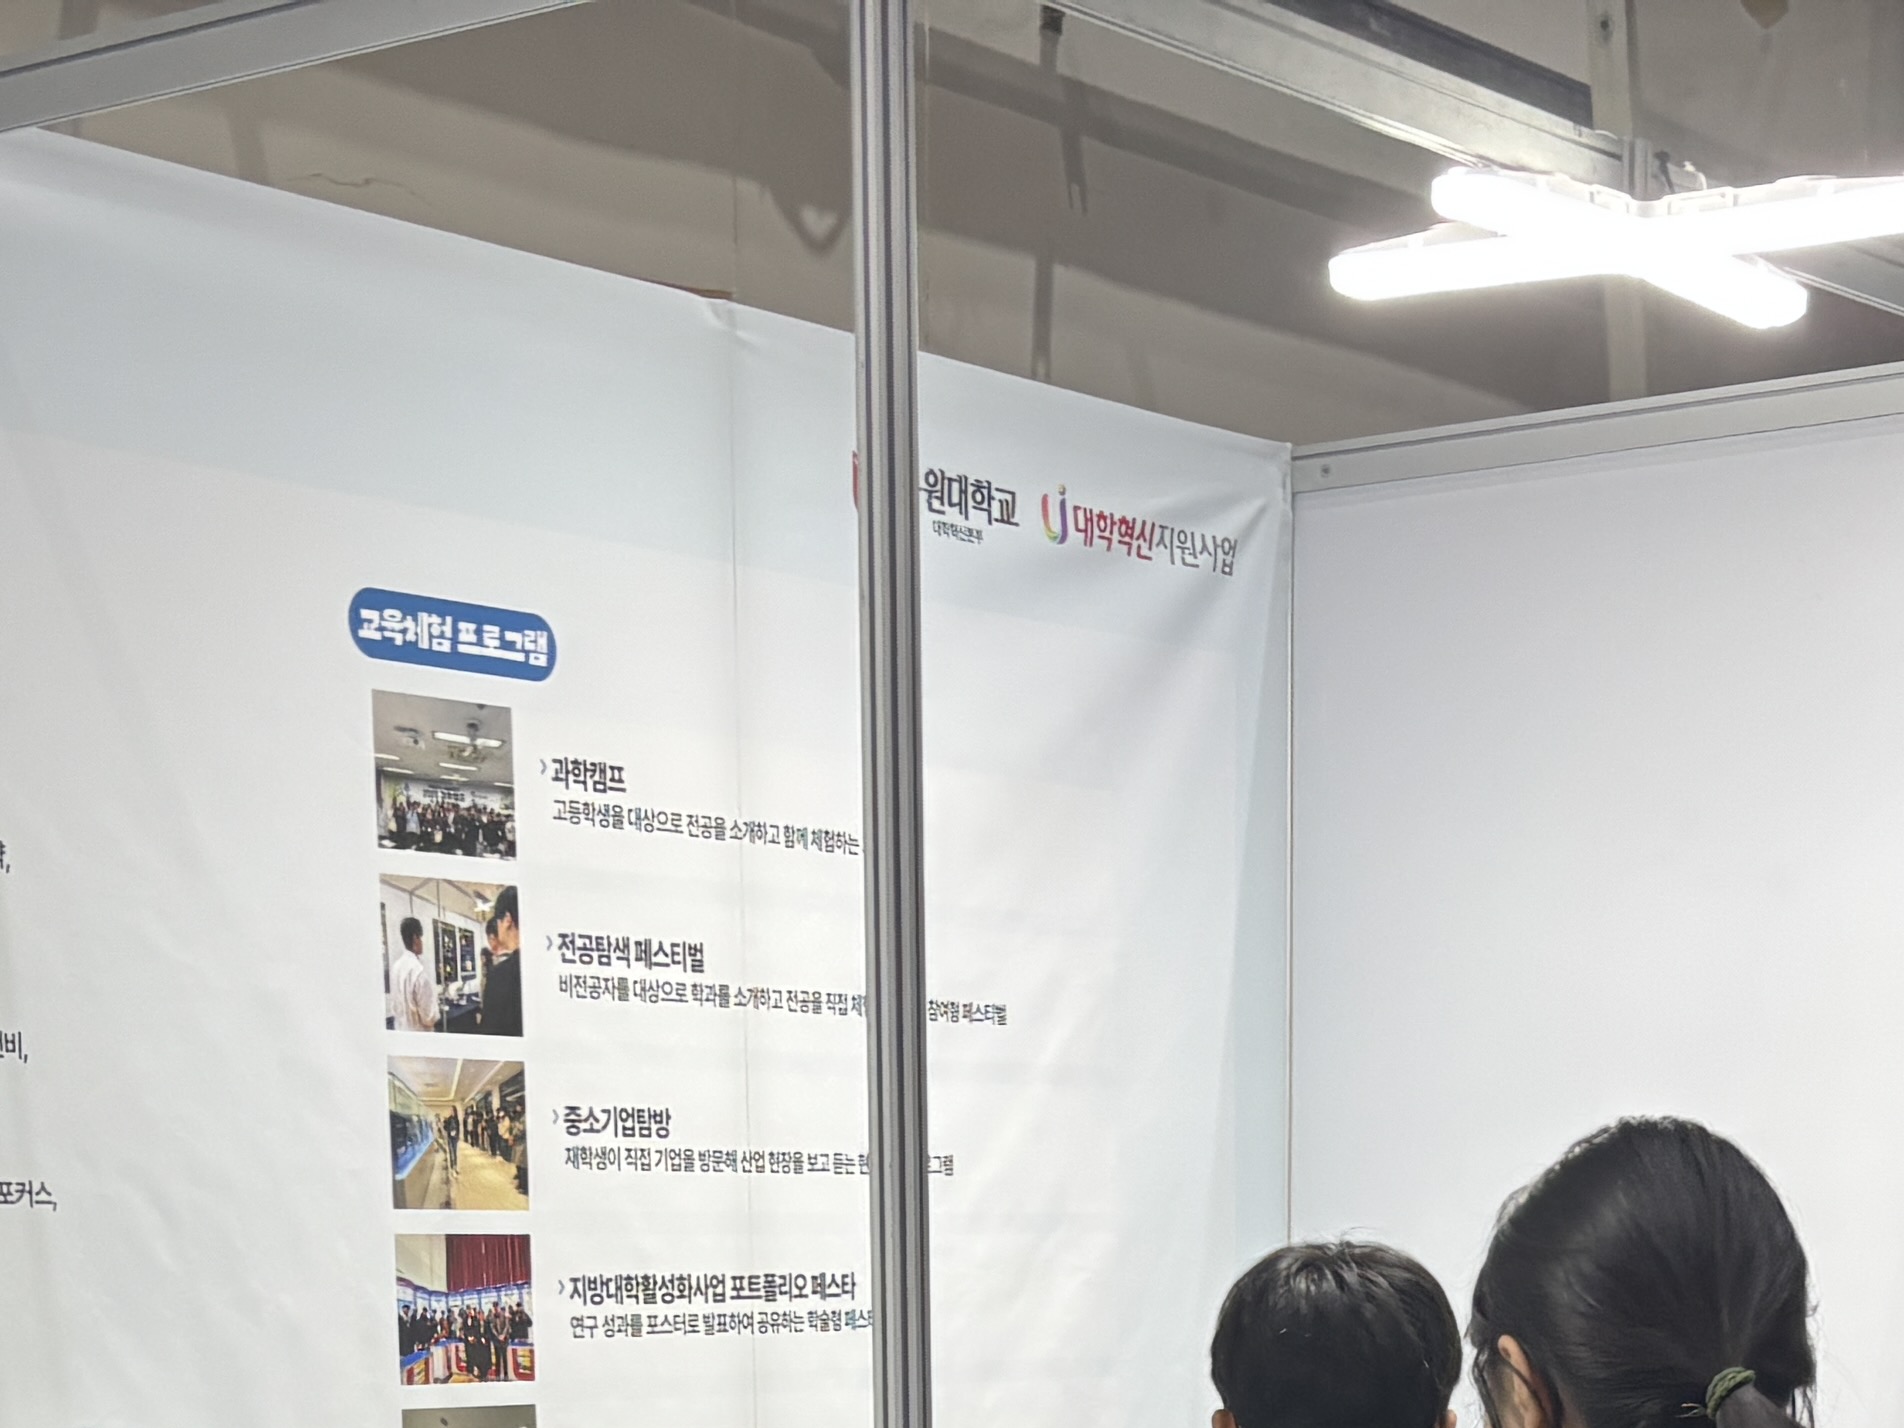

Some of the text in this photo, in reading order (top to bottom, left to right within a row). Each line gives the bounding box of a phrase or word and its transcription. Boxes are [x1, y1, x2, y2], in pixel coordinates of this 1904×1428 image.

[1073, 505, 1238, 576] 대학혁신지원사업
[358, 609, 547, 666] 교육체험 프로그램
[552, 757, 626, 793] 과학캠프
[628, 808, 684, 834] 대상으로
[686, 815, 726, 841] 전공을
[558, 932, 704, 973] 전공탐색 페스티벌
[633, 979, 688, 1003] 대상으로
[563, 1106, 671, 1138] 중소기업탐방
[625, 1148, 765, 1173] 직접 산업
[569, 1272, 856, 1306] 지방대학활성화사업 포트폴리오 페스타
